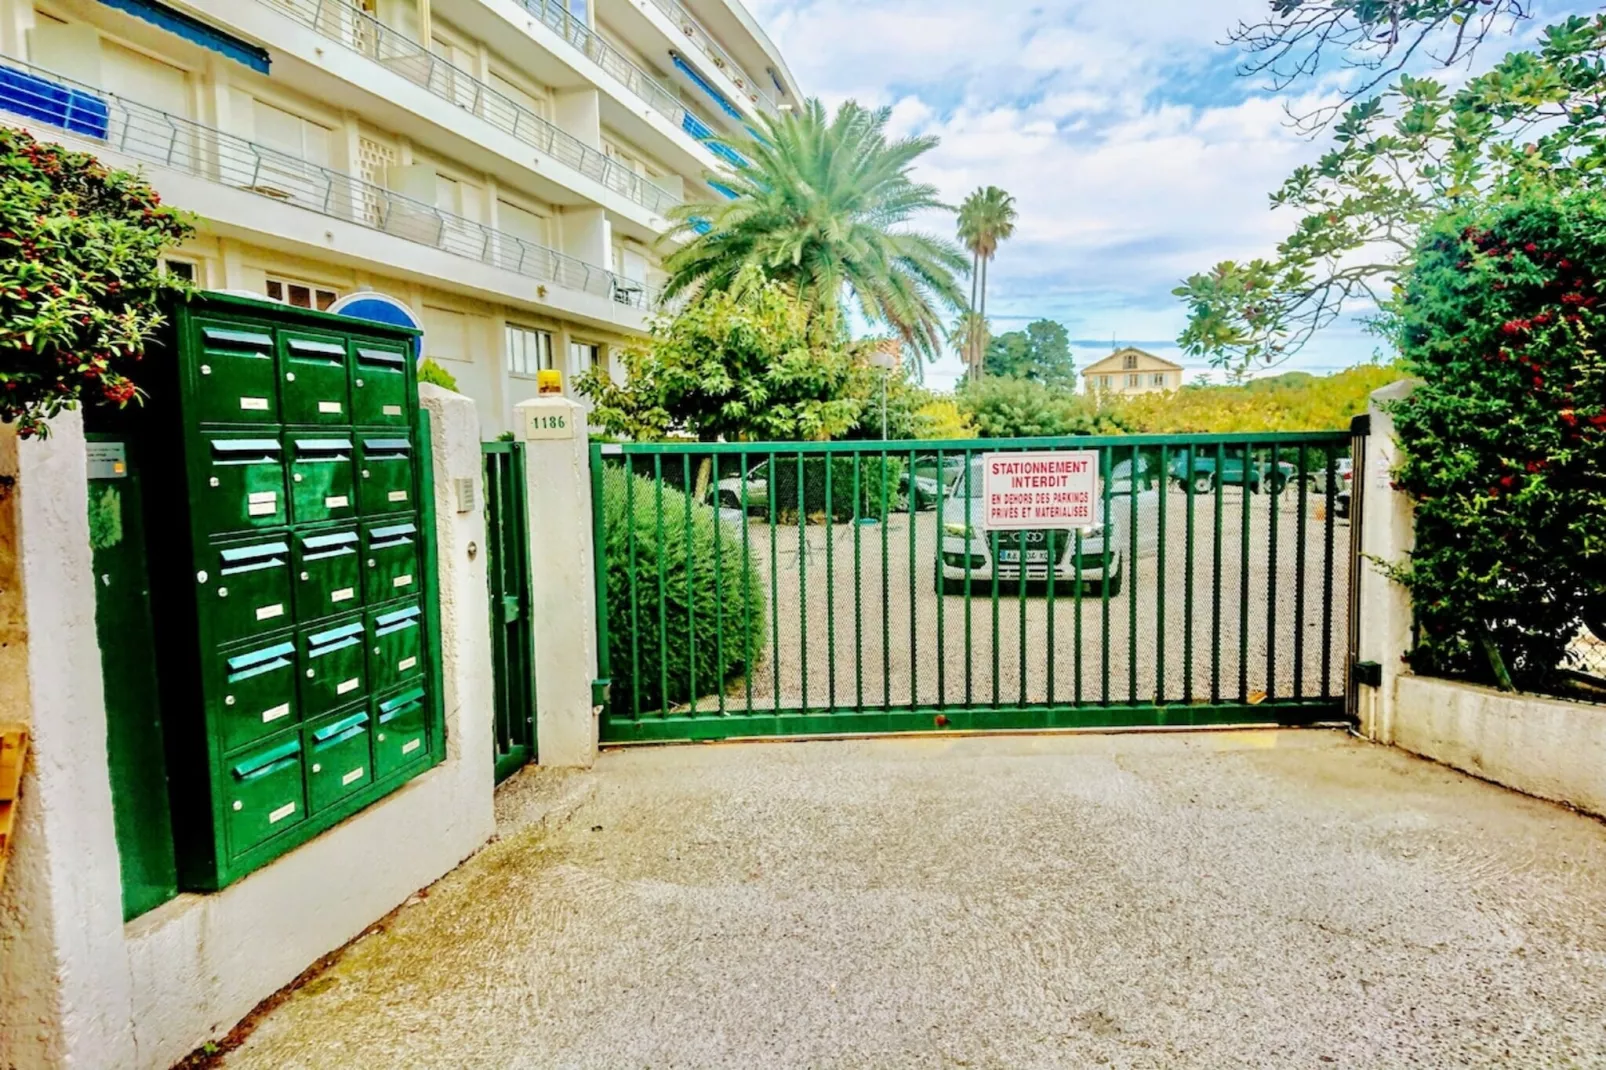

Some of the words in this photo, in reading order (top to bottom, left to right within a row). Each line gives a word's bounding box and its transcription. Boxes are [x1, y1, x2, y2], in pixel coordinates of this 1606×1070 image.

[533, 416, 565, 429] 1186
[992, 461, 1088, 475] STATIONNEMENT
[1011, 476, 1068, 488] INTERDIT
[992, 493, 1001, 504] EN
[1004, 493, 1033, 504] DEHORS
[1035, 492, 1050, 504] DES
[1053, 491, 1088, 503] PARKINGS
[1022, 507, 1032, 518] ET
